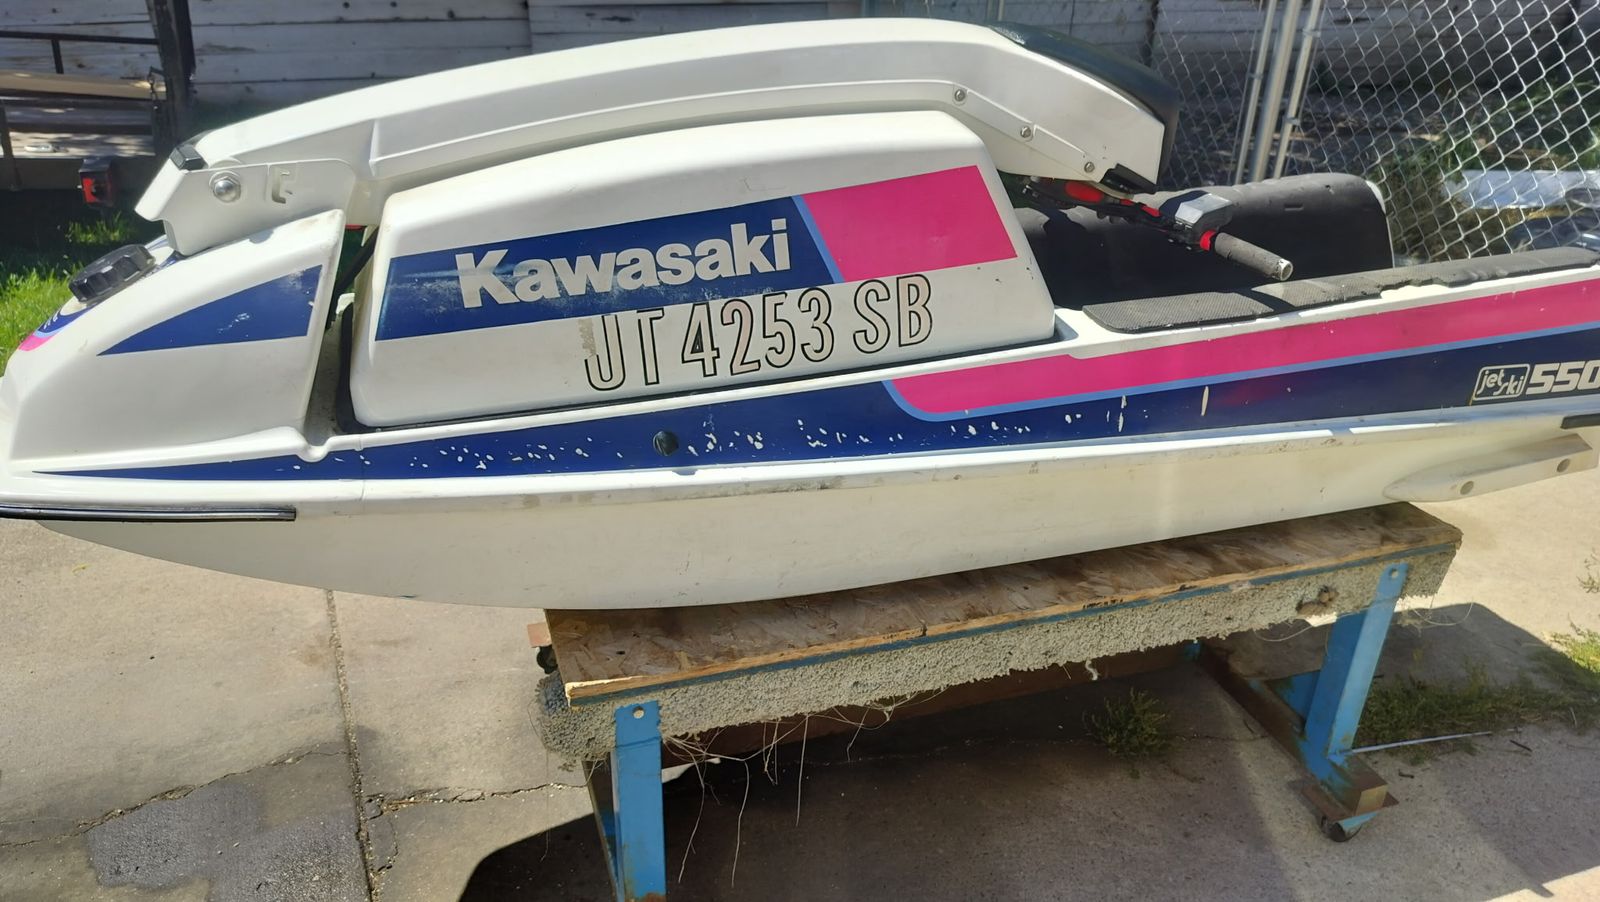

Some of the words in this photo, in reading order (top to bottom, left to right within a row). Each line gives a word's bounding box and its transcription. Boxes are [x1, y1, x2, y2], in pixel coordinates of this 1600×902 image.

[455, 218, 791, 309] Kawasaki
[681, 288, 834, 378] 4253
[853, 274, 932, 353] SB
[1476, 369, 1505, 395] jet
[1493, 375, 1524, 396] ski
[1526, 360, 1600, 395] 550
